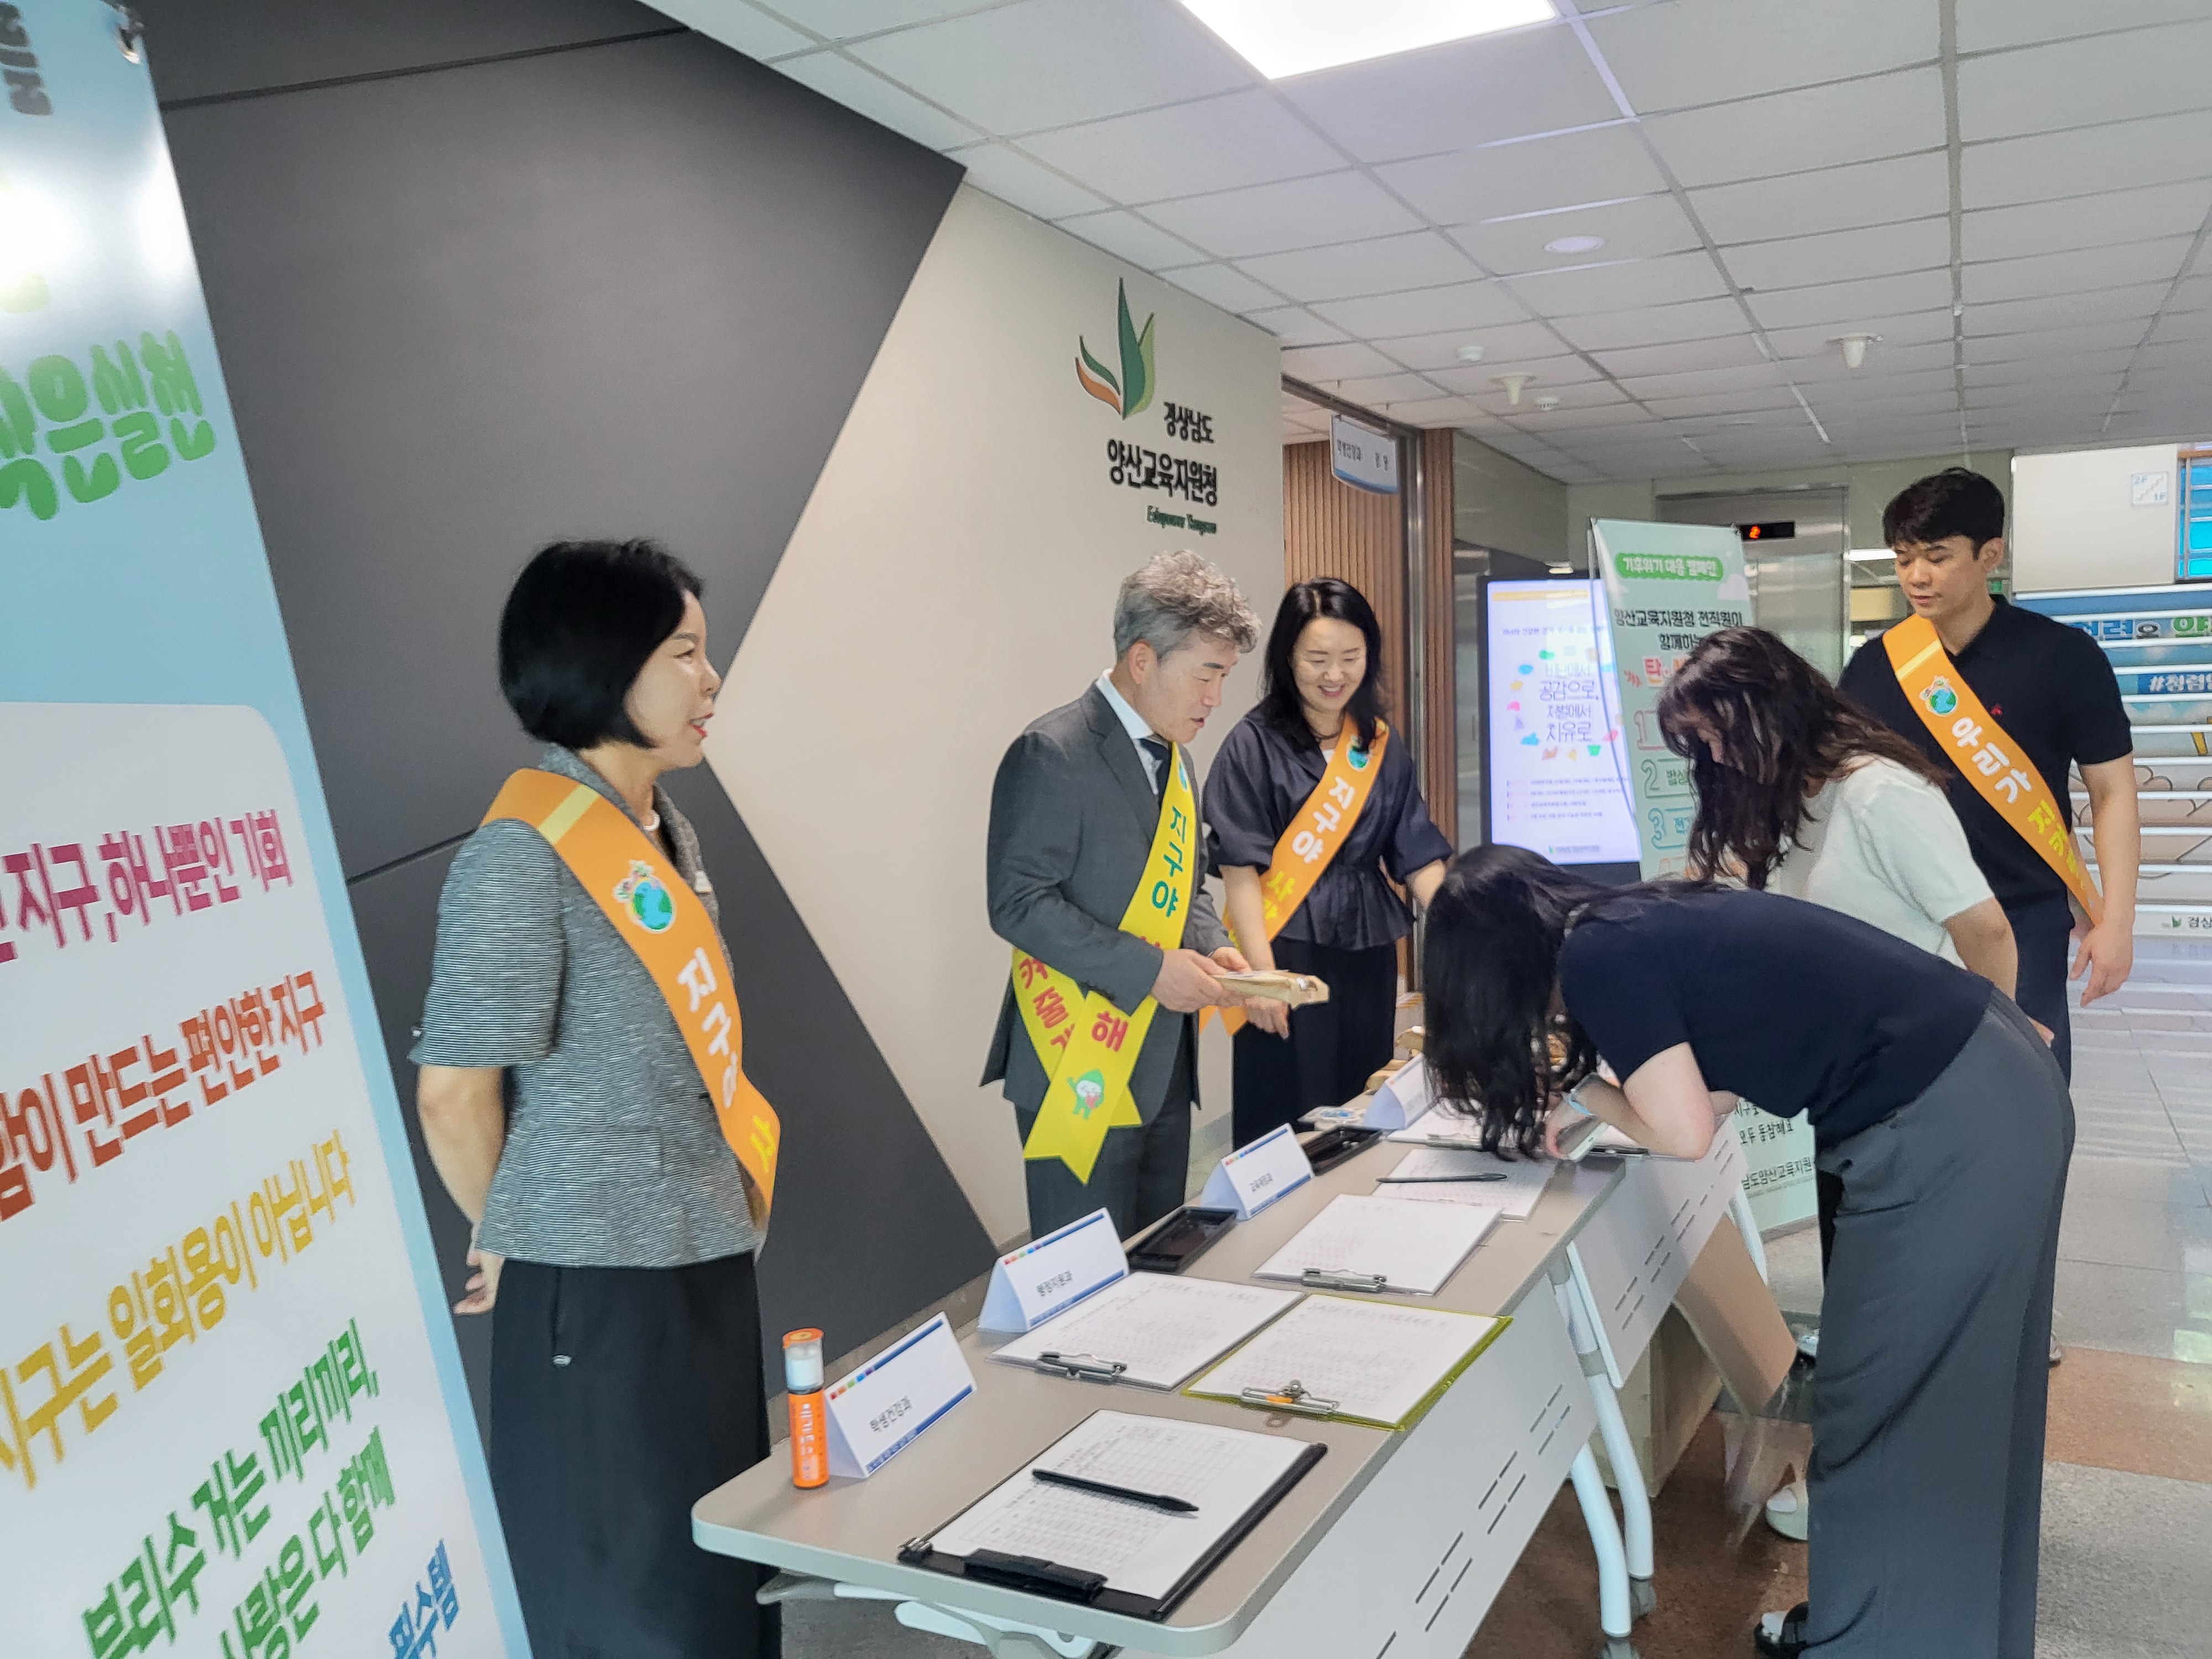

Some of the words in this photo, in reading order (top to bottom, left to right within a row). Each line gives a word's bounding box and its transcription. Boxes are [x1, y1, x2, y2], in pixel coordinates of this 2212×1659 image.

[1164, 401, 1214, 443] 경상남도
[1108, 439, 1217, 507] 양산교육지원청
[1623, 556, 1663, 573] 기후위기
[1665, 557, 1685, 576] 대응
[1614, 609, 1694, 627] 양산교육지원청
[1697, 610, 1742, 628] 전직원이
[1539, 680, 1599, 701] 공감으로,
[1546, 721, 1593, 743] 치유로
[1952, 716, 2033, 804] 우리가
[1292, 775, 1355, 864] 지구야
[230, 808, 294, 891] 기회
[1151, 805, 1187, 918] 지구야
[63, 1035, 192, 1168] 만드는
[180, 987, 280, 1107] 편안한
[272, 969, 326, 1054] 지구
[248, 1129, 356, 1265] 아닙니다
[1036, 1269, 1075, 1298] 행정지원과
[869, 1395, 914, 1434] 학생건강과
